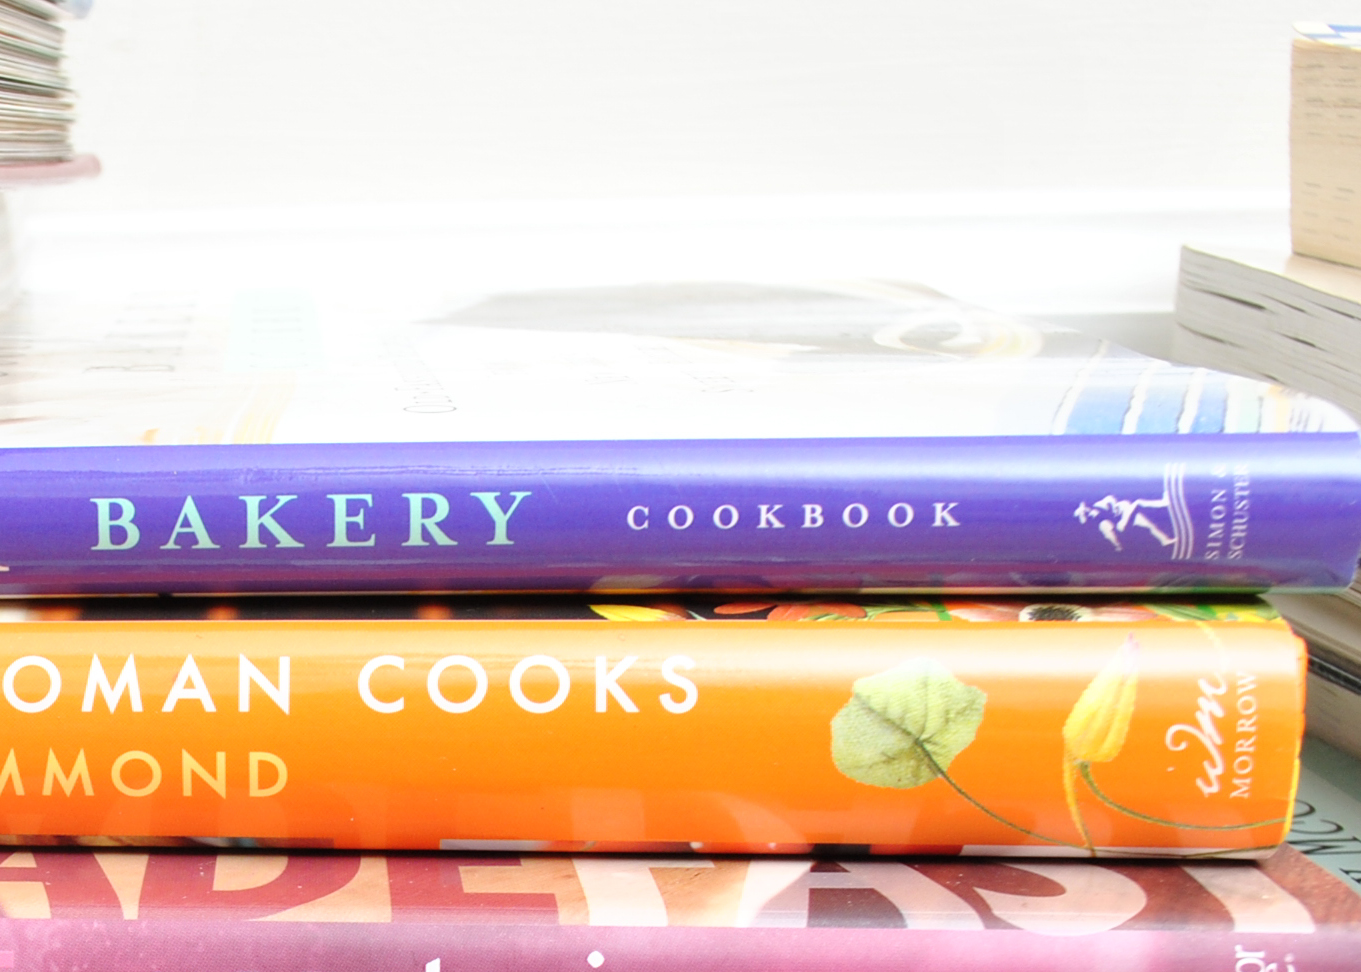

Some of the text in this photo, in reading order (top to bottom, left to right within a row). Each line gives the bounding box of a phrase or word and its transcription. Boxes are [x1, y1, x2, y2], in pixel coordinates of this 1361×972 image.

[89, 490, 532, 552] BAKERY
[626, 501, 961, 531] COOKBOOK
[1204, 488, 1228, 561] SIMON
[1227, 464, 1251, 560] SCHUSTER
[357, 653, 699, 715] COOKS
[1229, 671, 1259, 799] MORROW
